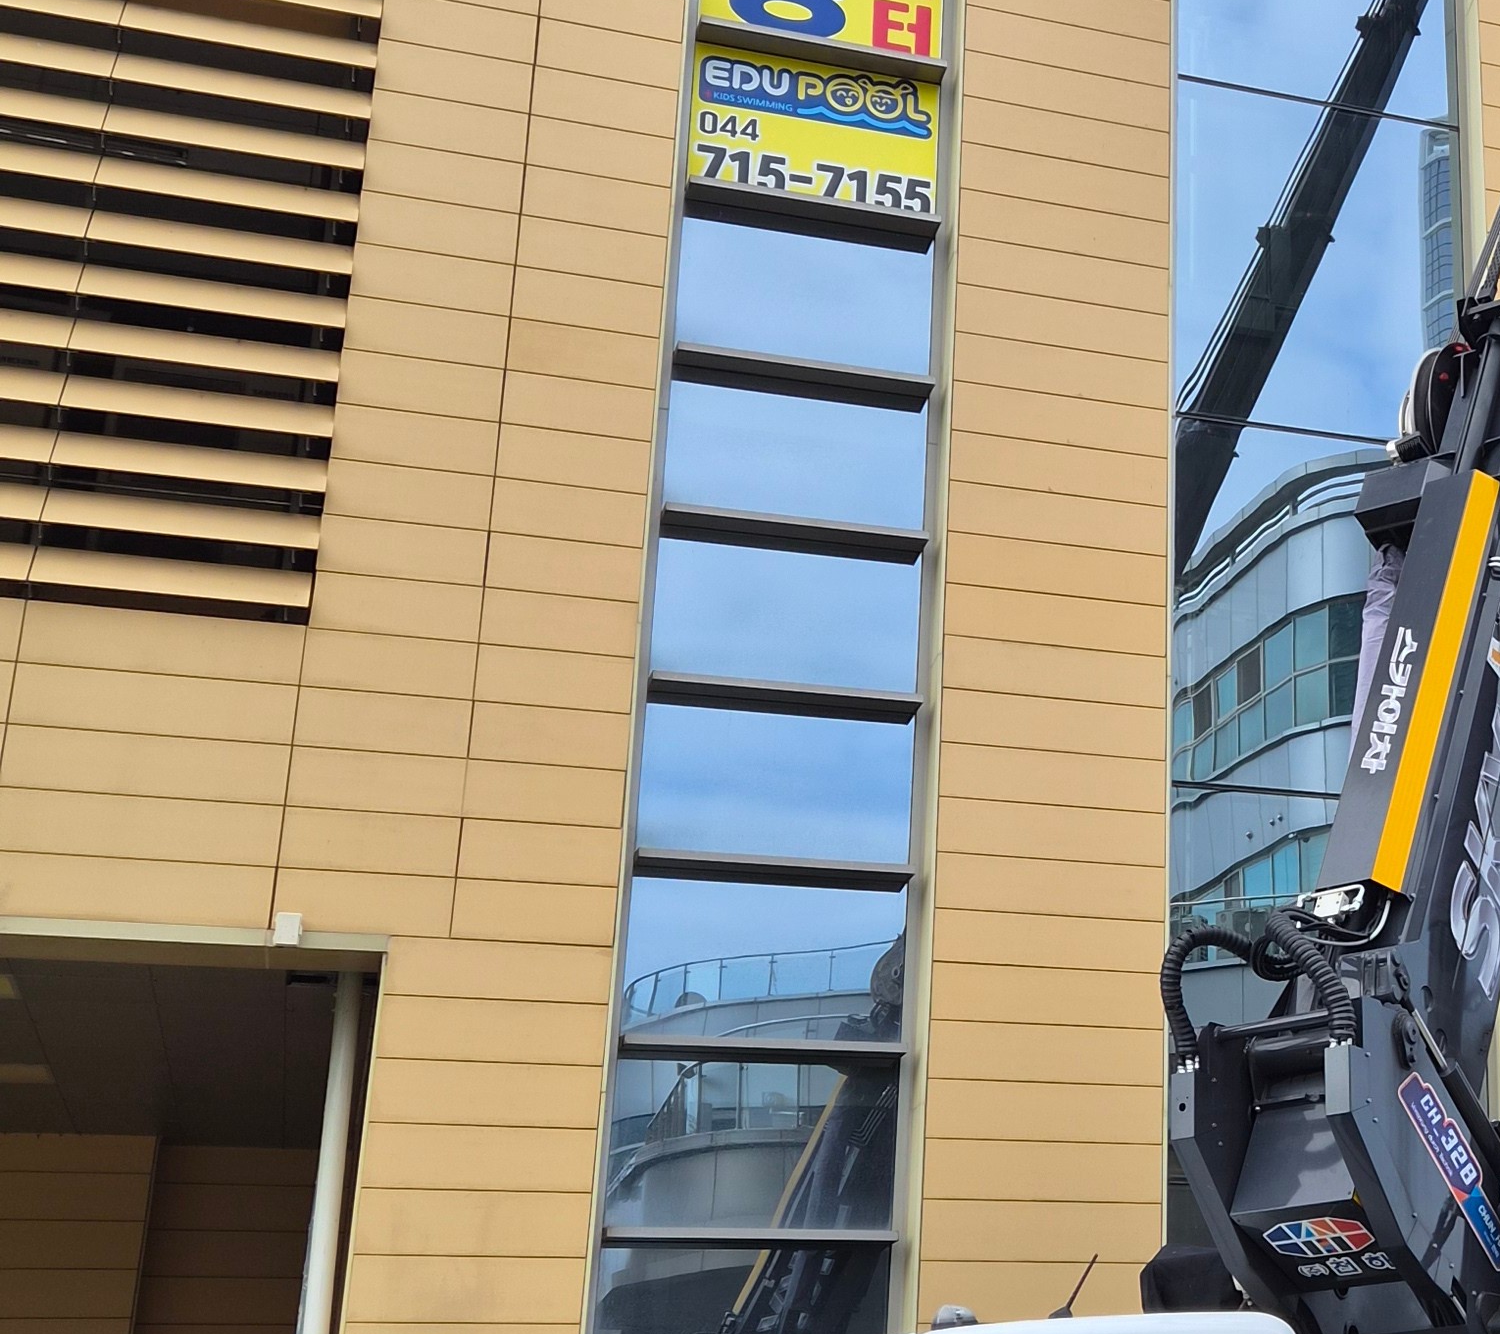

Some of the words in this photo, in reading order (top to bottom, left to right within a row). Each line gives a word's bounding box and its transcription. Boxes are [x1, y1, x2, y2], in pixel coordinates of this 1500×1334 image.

[698, 110, 760, 142] 044
[712, 91, 735, 104] KIDS
[737, 95, 793, 113] SWIMMING
[697, 143, 932, 215] 715-7155
[1360, 626, 1418, 775] 스카이차
